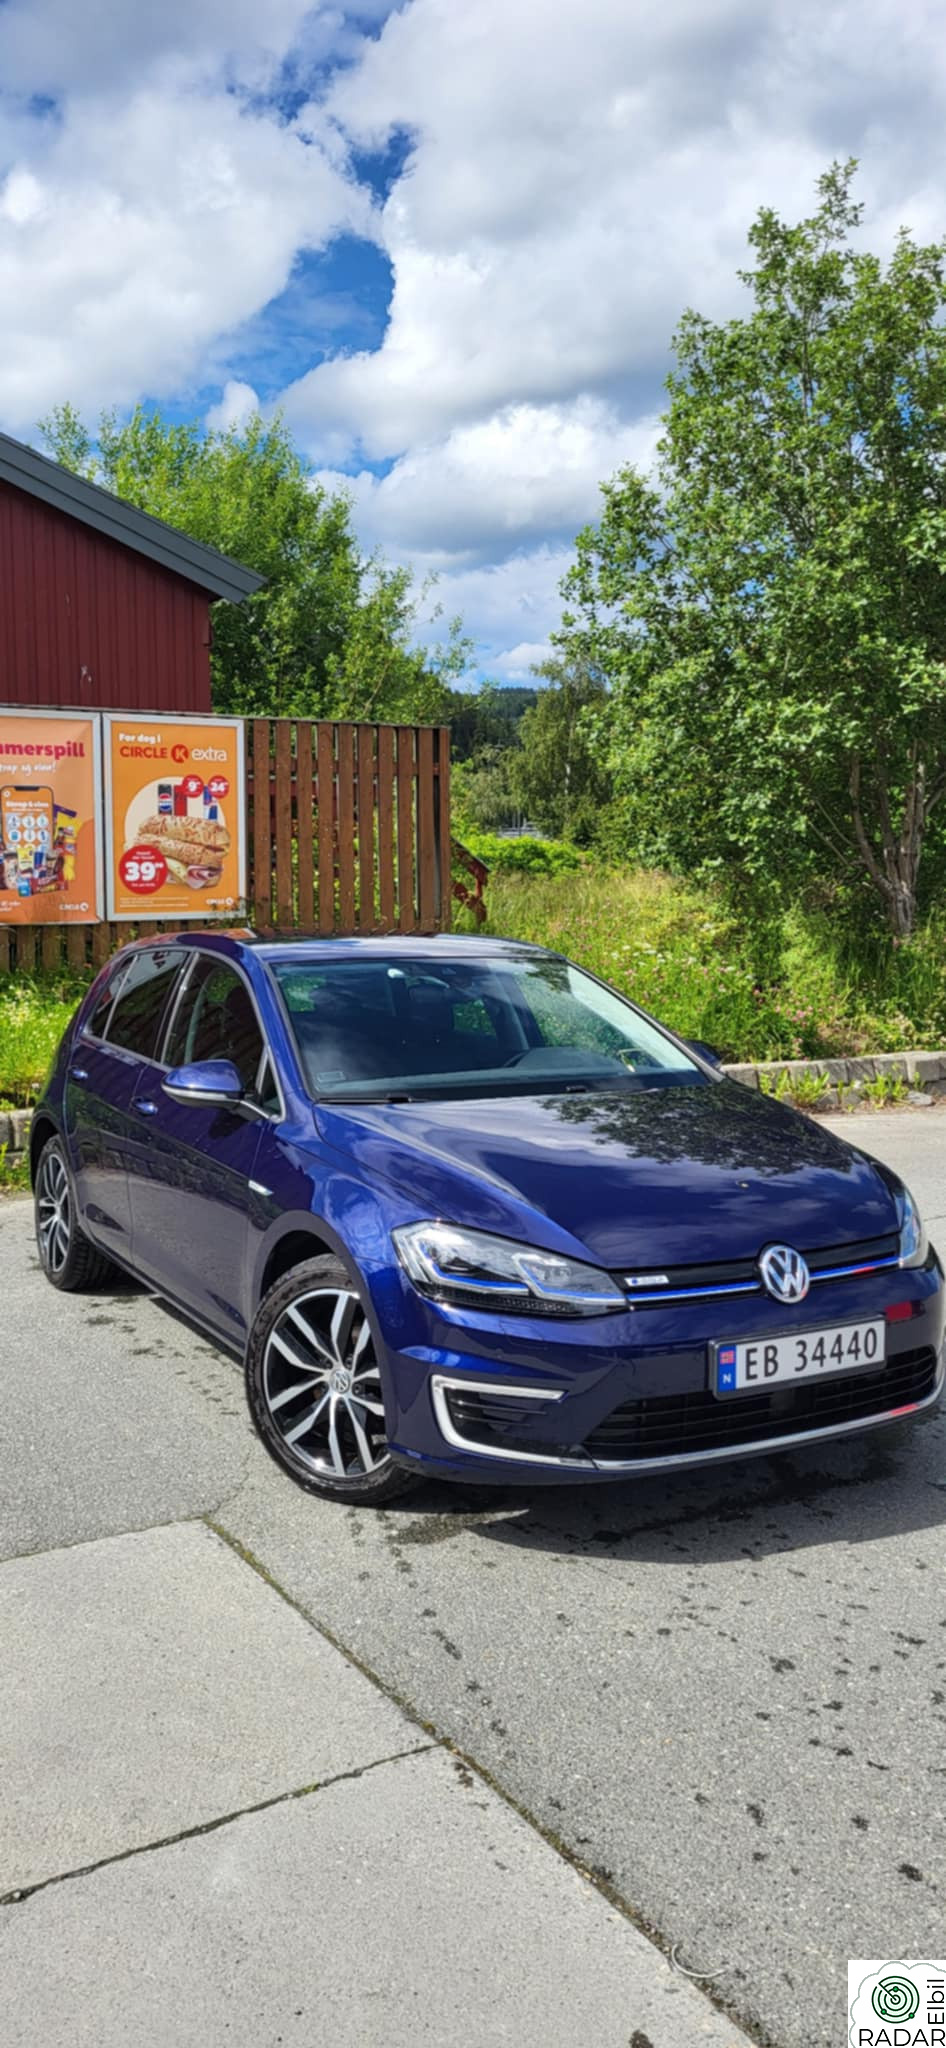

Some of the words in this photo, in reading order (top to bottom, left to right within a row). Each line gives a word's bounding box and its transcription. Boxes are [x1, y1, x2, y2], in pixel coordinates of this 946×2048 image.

[0, 741, 85, 760] merspill
[120, 746, 167, 758] CIRCLE
[172, 745, 188, 762] K
[192, 747, 227, 761] extra
[125, 861, 155, 881] 39
[745, 1344, 778, 1381] EB
[794, 1327, 877, 1372] 34440
[722, 1373, 732, 1384] N
